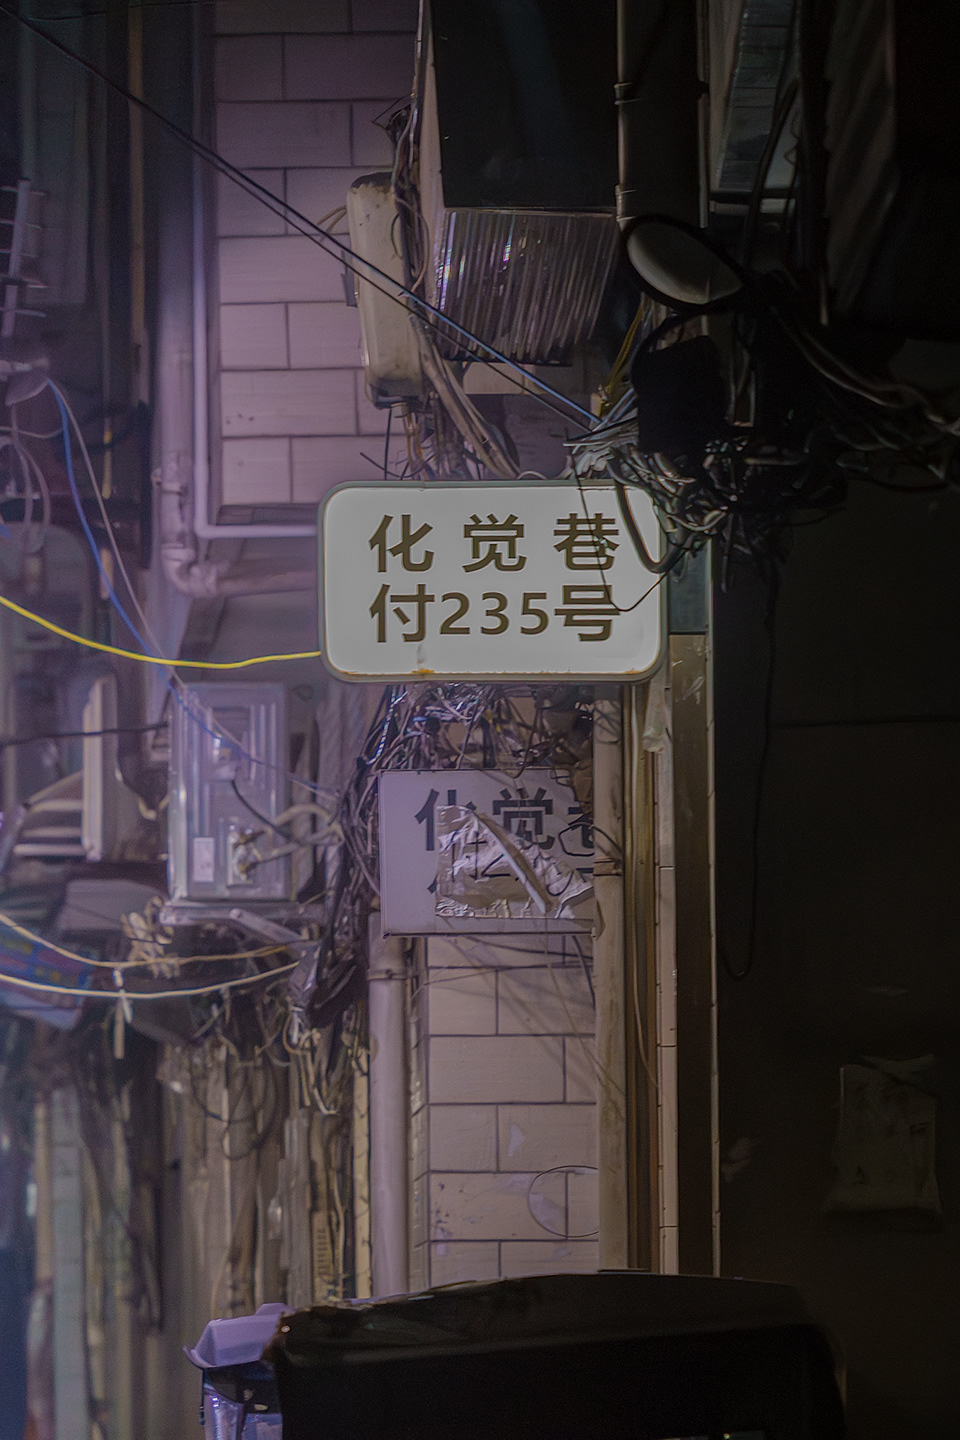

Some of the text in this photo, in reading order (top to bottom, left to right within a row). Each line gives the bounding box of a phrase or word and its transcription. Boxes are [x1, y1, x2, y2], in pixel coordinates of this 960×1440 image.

[369, 513, 621, 573] 化觉巷
[369, 583, 621, 643] 付235号
